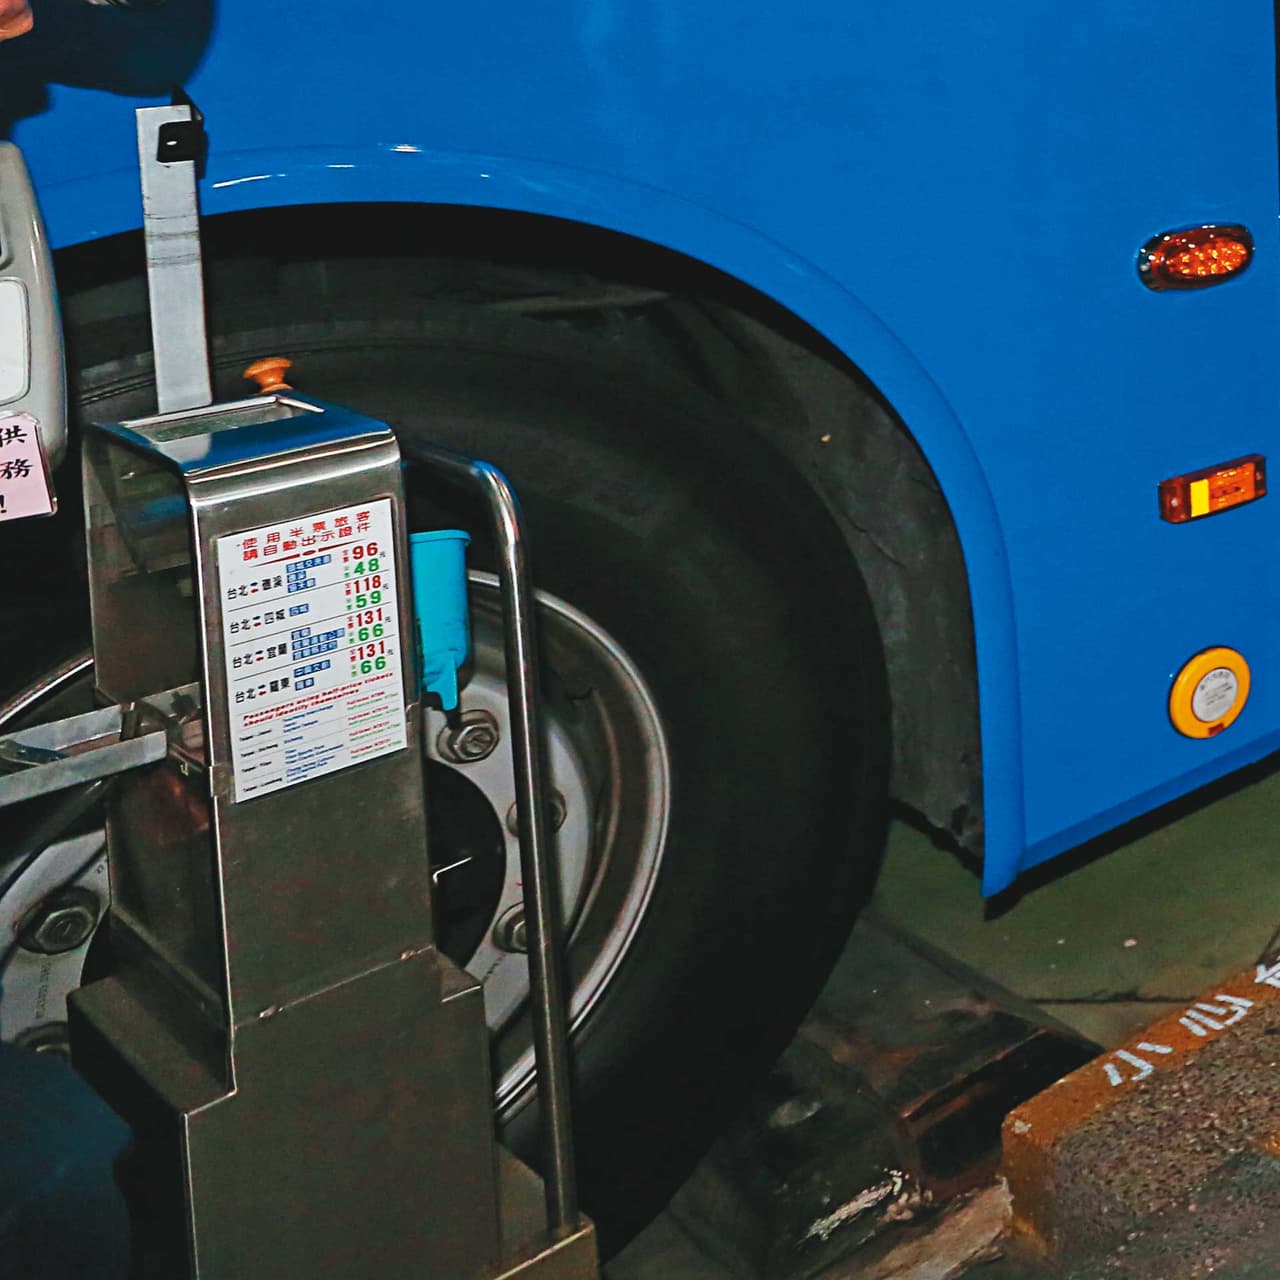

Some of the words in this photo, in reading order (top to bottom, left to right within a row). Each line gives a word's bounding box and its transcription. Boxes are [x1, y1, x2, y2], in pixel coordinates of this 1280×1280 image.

[242, 511, 371, 550] 使用半票旅客
[242, 522, 372, 561] 請自動出示證件
[352, 542, 379, 560] 96
[354, 558, 380, 575] 48
[227, 584, 249, 600] 台北
[353, 575, 382, 594] 118
[356, 590, 382, 608] 59
[230, 619, 251, 634] 台北
[356, 608, 383, 627] 131
[358, 623, 384, 641] 66
[358, 641, 385, 660] 131
[232, 654, 254, 669] 台北
[360, 656, 386, 674] 66
[235, 688, 257, 703] 台北
